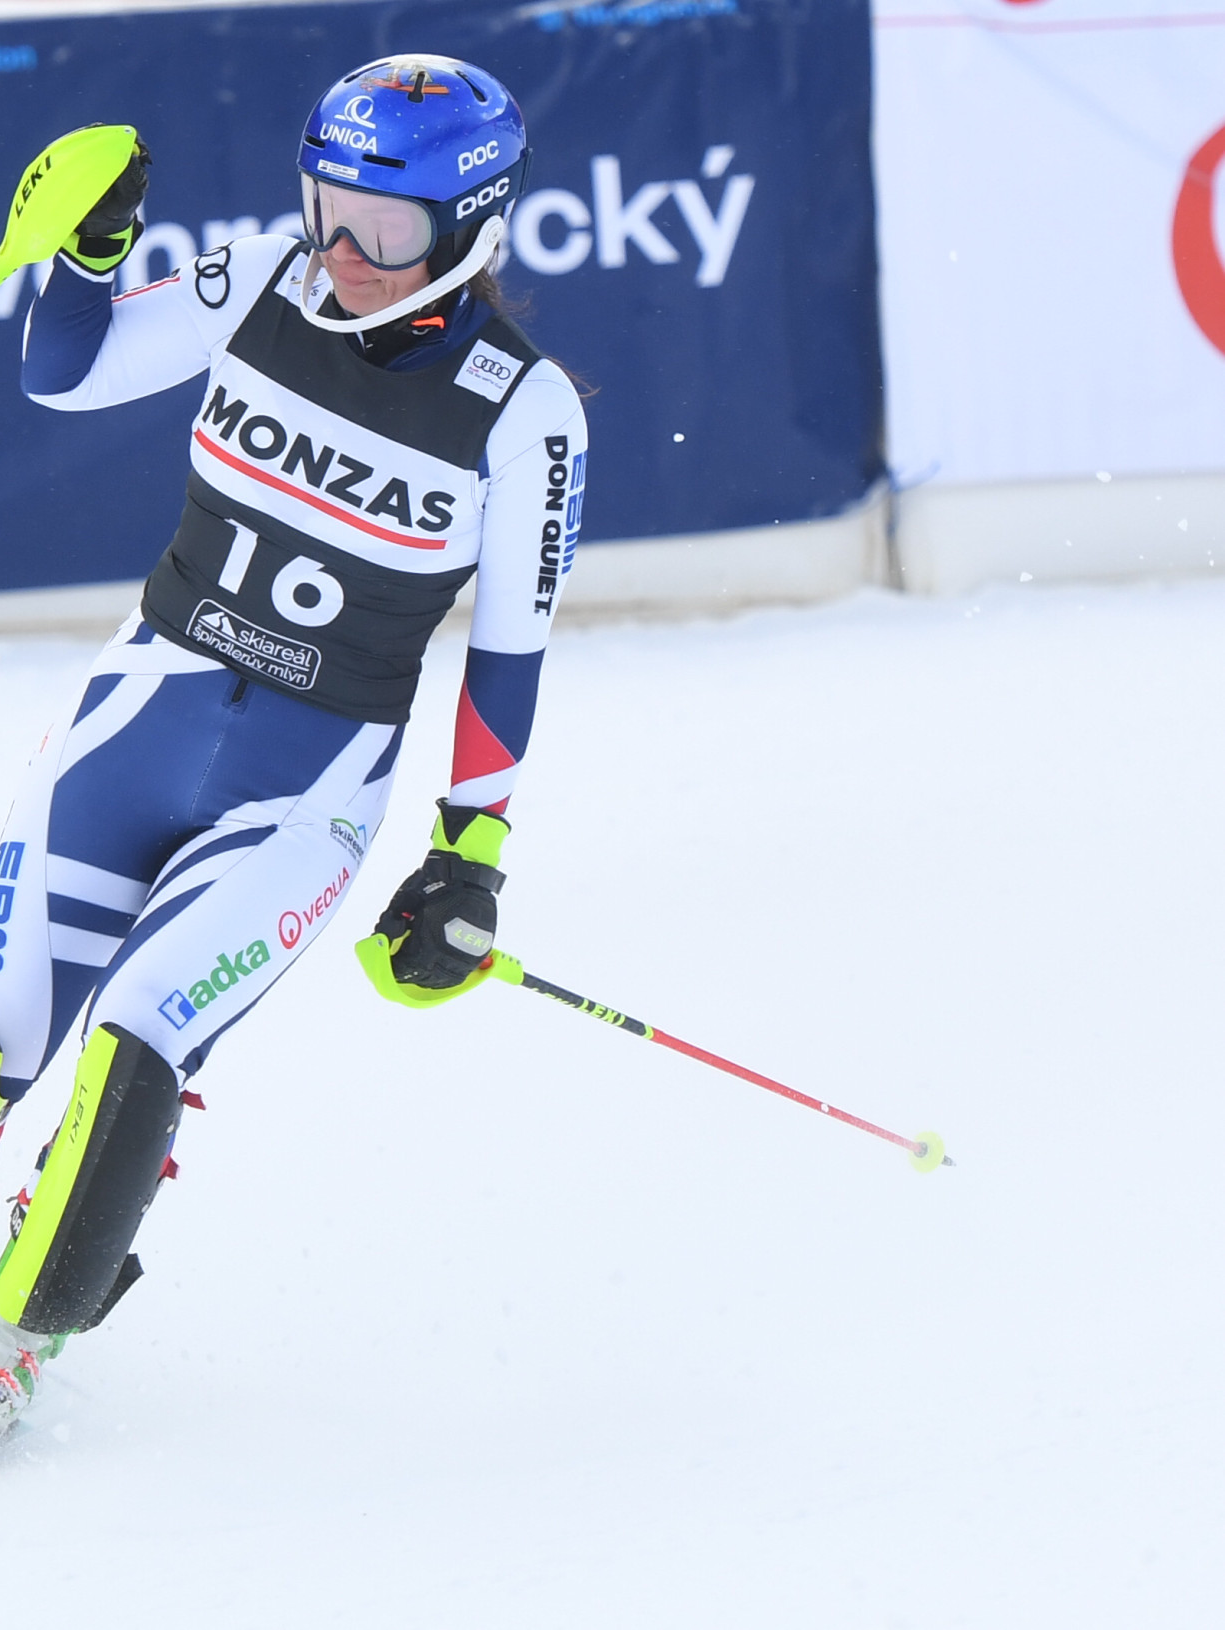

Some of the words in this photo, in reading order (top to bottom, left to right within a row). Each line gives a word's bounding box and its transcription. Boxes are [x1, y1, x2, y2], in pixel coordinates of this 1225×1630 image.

[319, 122, 378, 155] UNIQA
[13, 155, 54, 220] LEKI
[200, 383, 457, 533] MONZAS
[544, 434, 569, 512] DON
[215, 517, 344, 627] 16
[192, 624, 267, 669] špindlerův
[267, 663, 308, 686] mlýn
[238, 629, 313, 668] skiareál
[302, 866, 350, 926] VEOLIA
[454, 928, 490, 949] LEKI
[157, 939, 271, 1031] radka
[577, 998, 626, 1026] LEKI
[69, 1083, 88, 1144] LEKI
